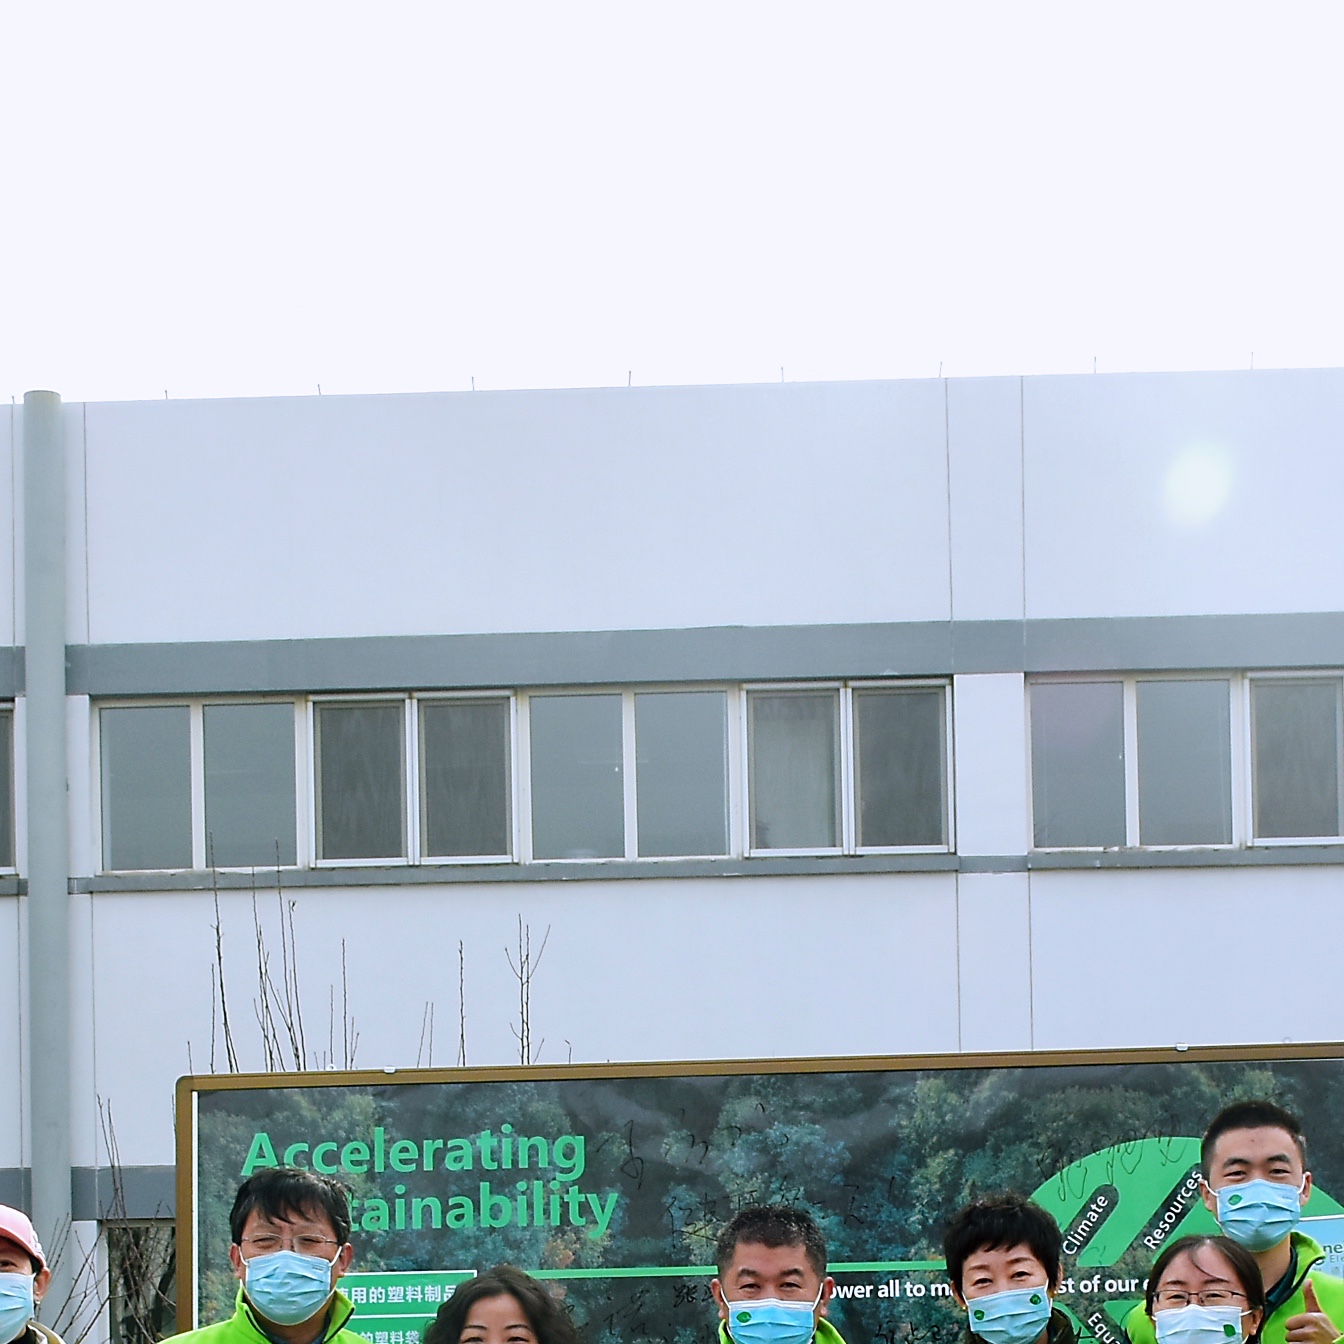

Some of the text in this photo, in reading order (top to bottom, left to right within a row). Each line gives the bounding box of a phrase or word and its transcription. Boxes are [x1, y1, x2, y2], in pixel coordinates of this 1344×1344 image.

[240, 1123, 586, 1182] Accelerating
[1062, 1195, 1109, 1255] Climate
[1143, 1170, 1203, 1250] Resources
[877, 1280, 900, 1297] all
[904, 1281, 926, 1297] to
[1079, 1274, 1101, 1293] of
[1104, 1279, 1139, 1293] our
